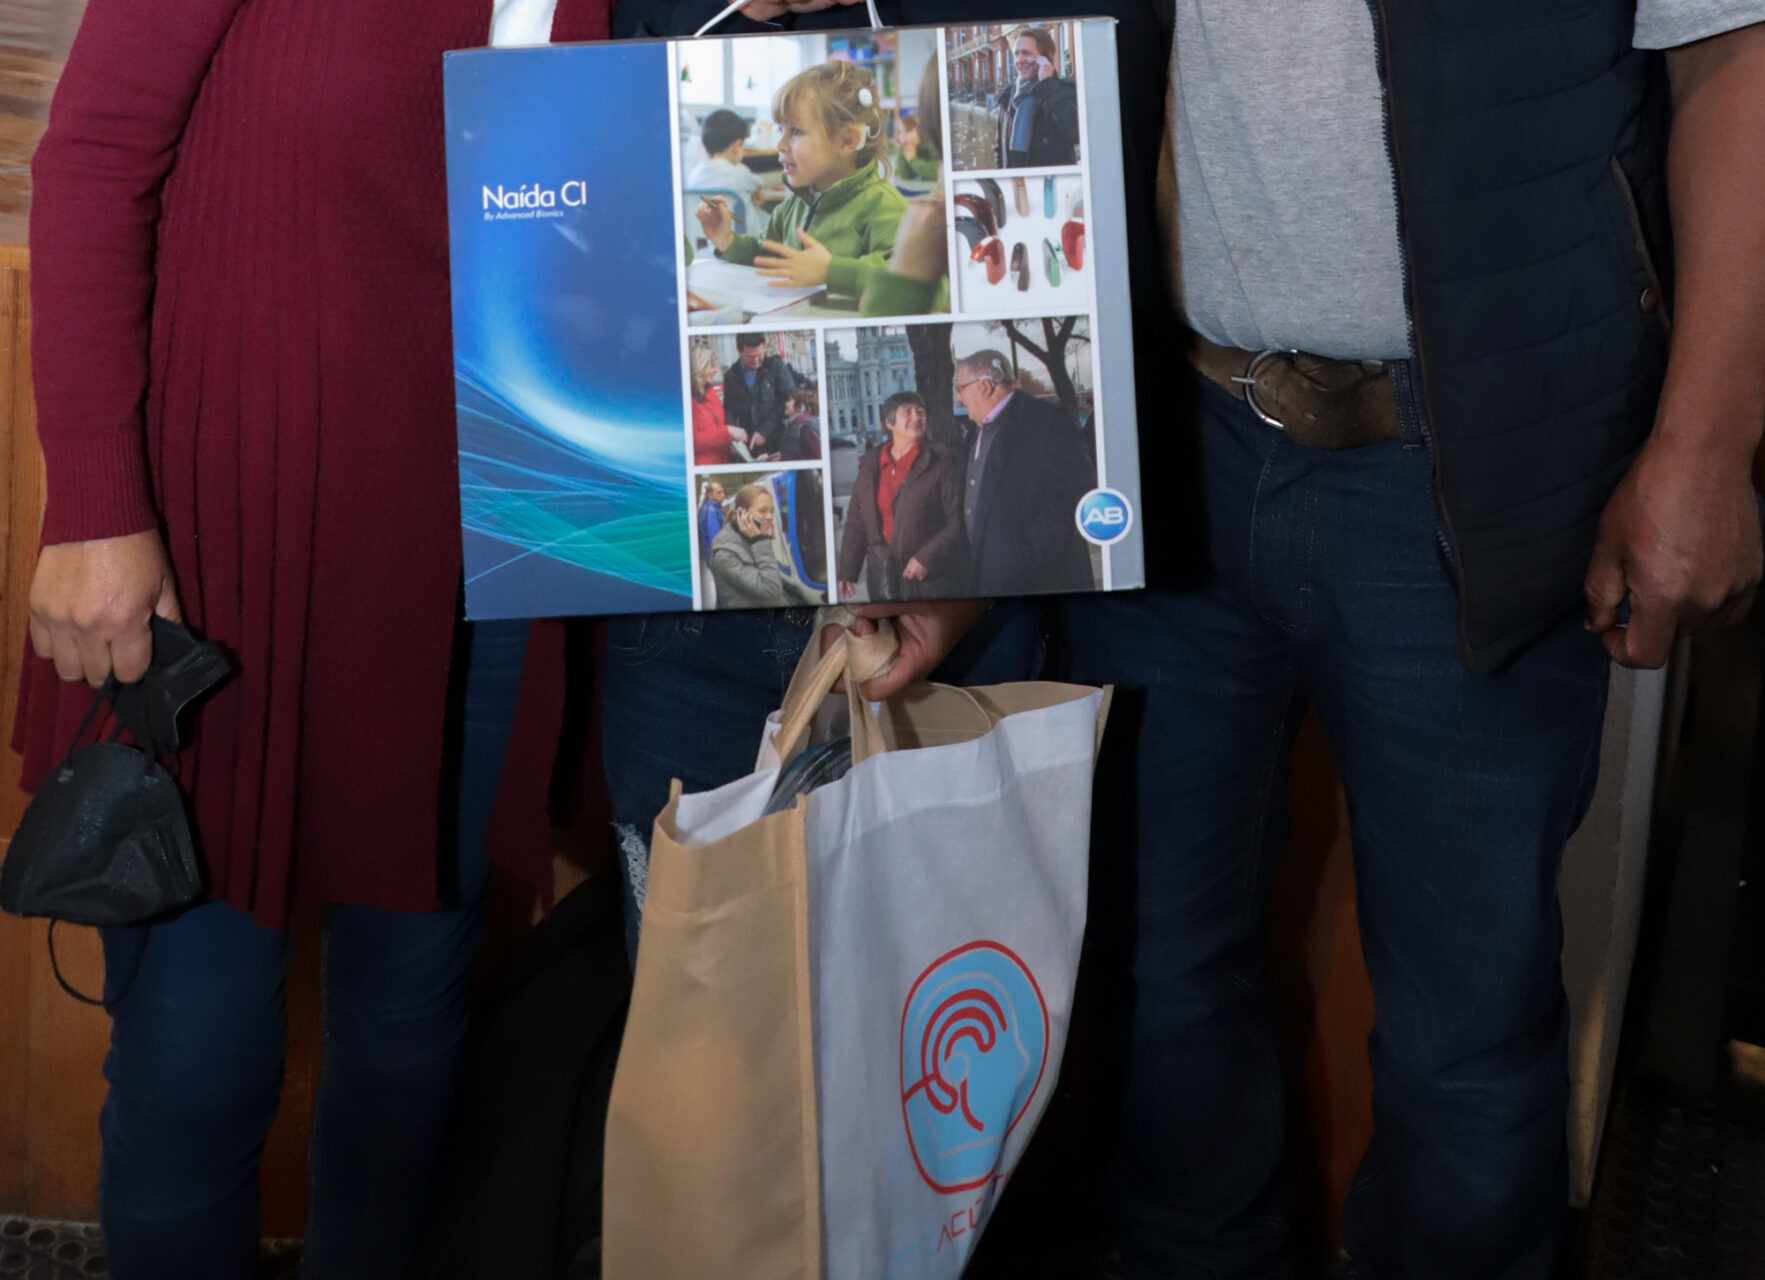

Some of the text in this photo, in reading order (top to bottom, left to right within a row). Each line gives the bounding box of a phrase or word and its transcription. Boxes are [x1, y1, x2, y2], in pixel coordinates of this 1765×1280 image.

[482, 180, 587, 210] Naída CI
[483, 209, 564, 221] By Advanced Bionics
[1083, 506, 1124, 527] AB
